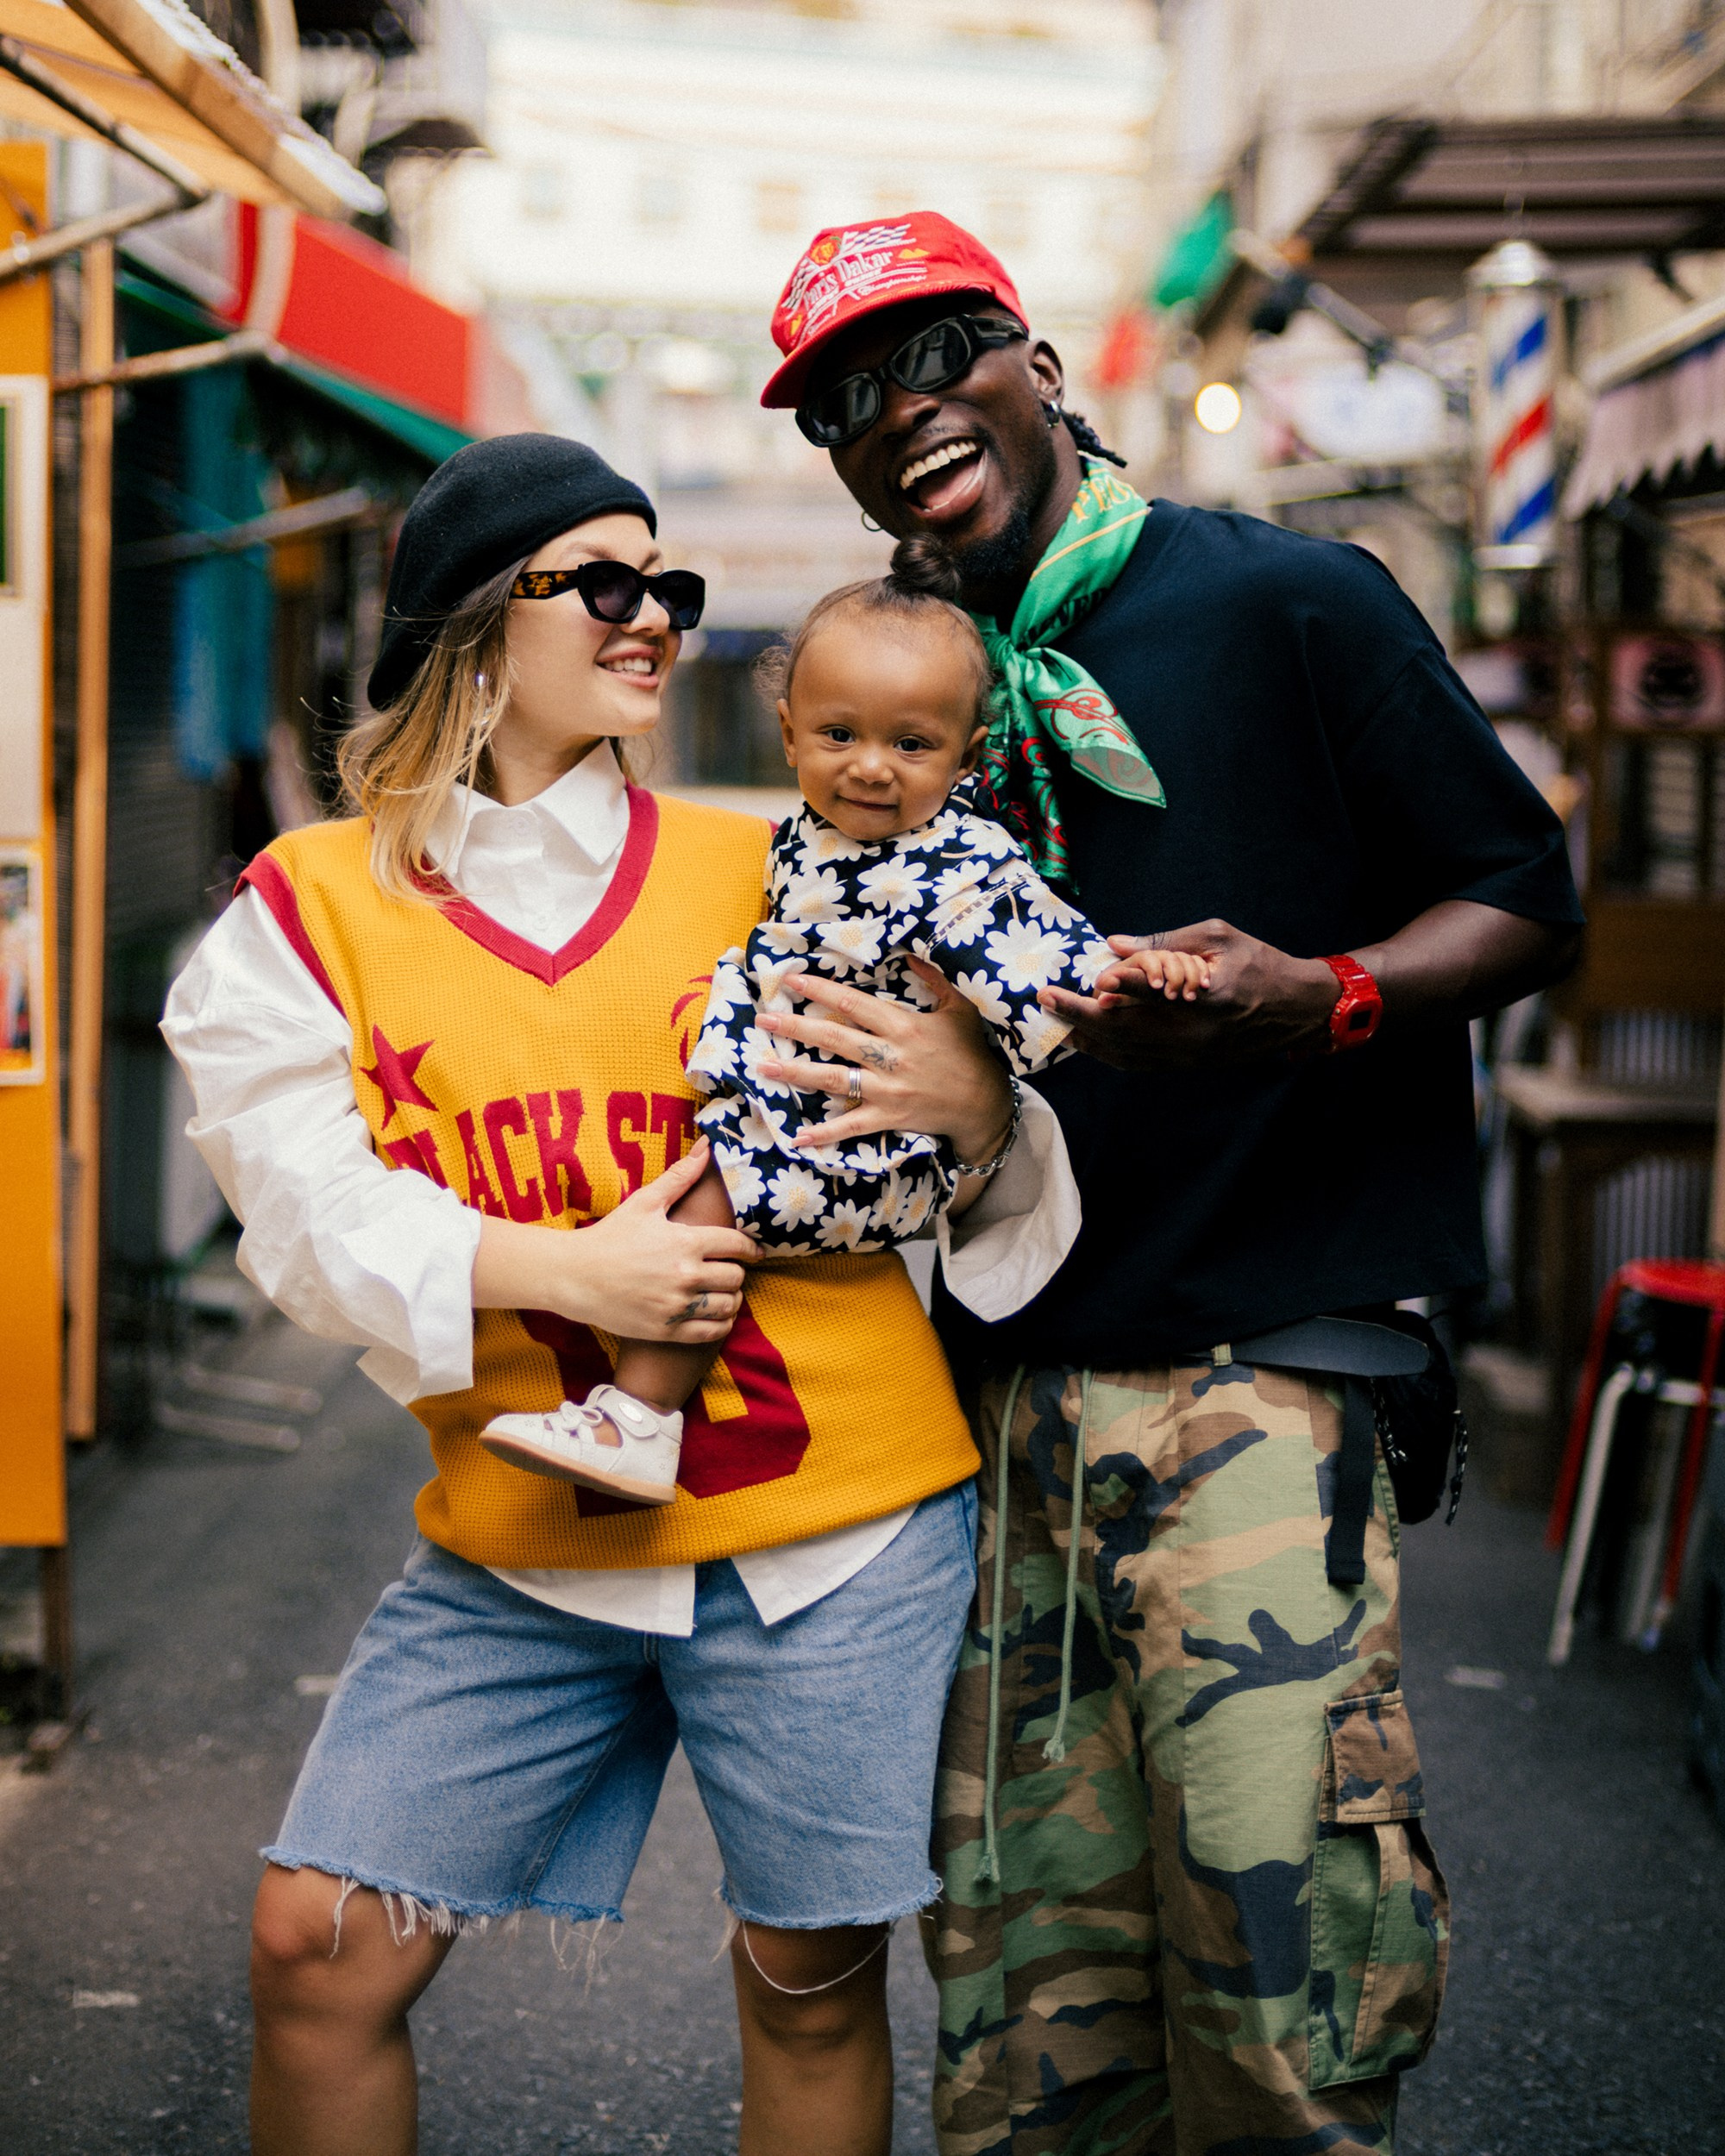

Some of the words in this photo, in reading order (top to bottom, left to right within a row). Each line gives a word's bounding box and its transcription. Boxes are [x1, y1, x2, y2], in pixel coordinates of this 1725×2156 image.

[803, 271, 839, 312] Paris
[834, 251, 894, 283] Dakar
[607, 1090, 704, 1205] ST
